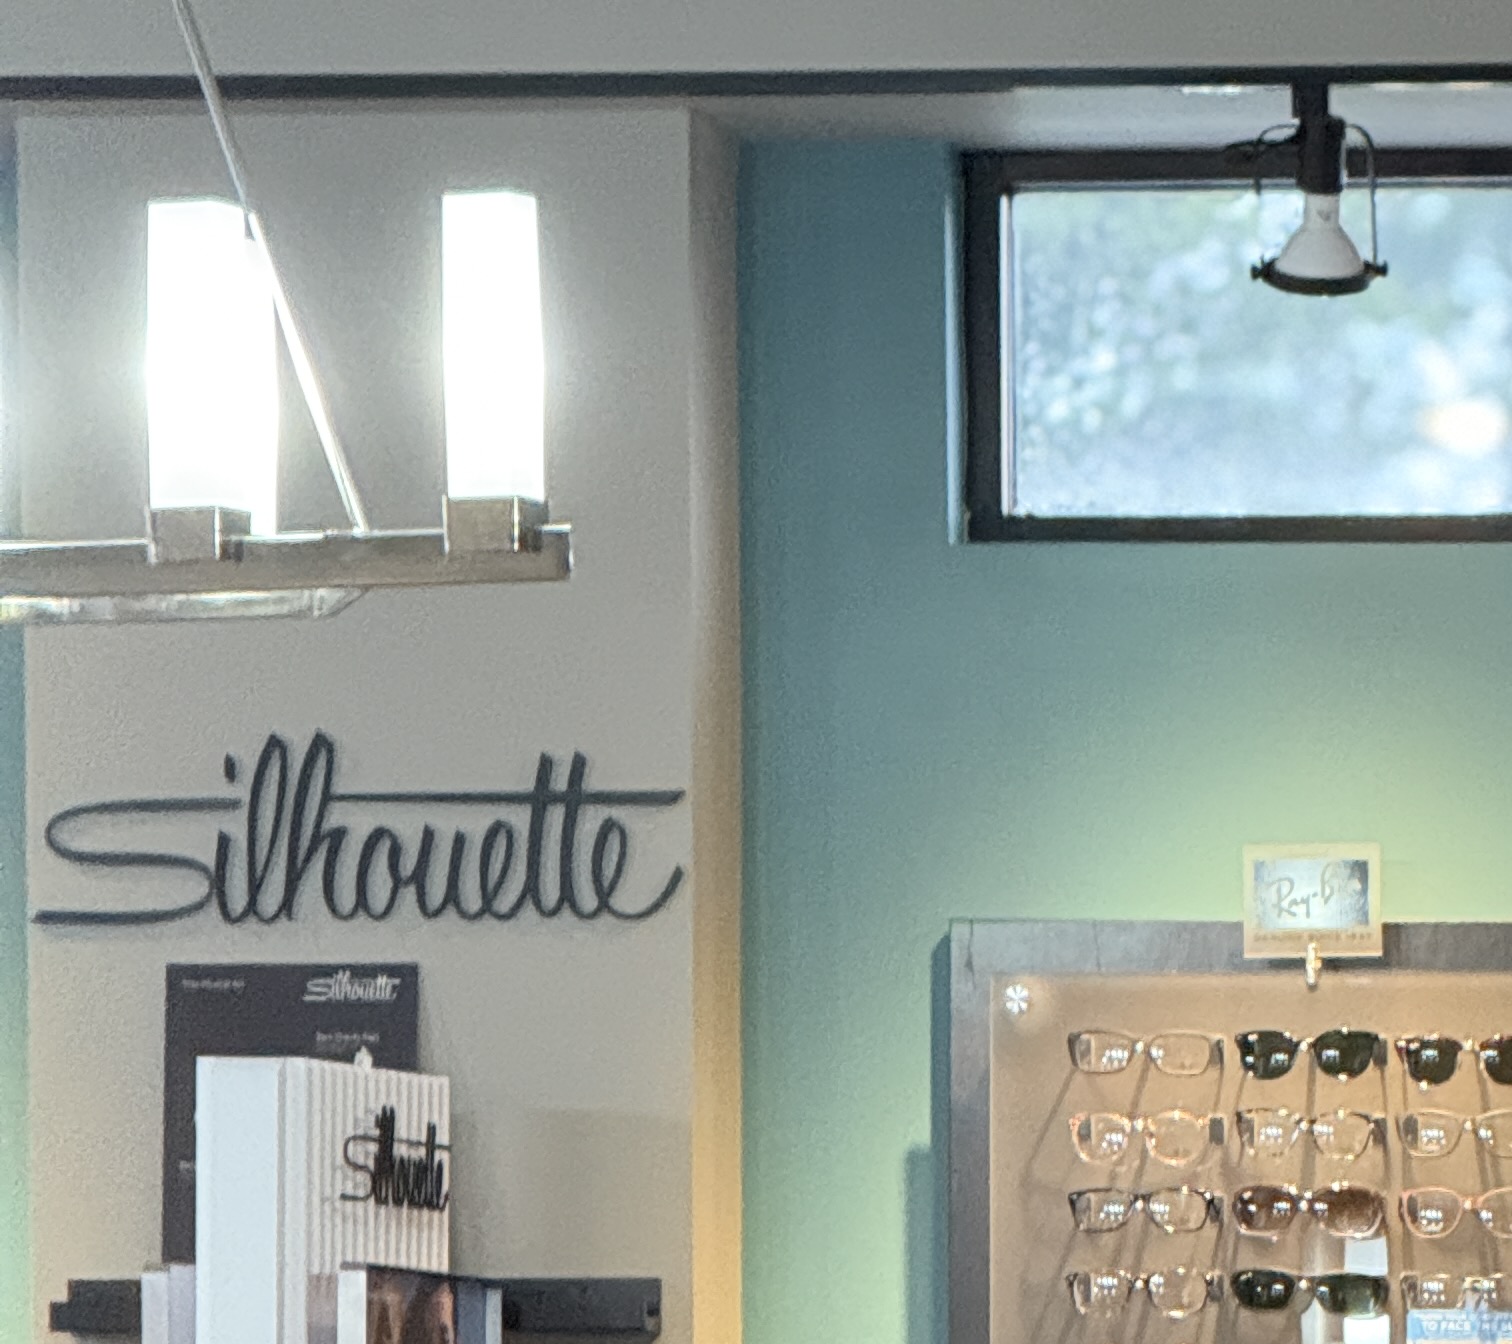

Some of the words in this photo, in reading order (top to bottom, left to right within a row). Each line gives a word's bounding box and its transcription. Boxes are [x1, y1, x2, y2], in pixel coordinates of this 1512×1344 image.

[32, 728, 686, 925] Silhouette
[302, 969, 401, 1003] Silhouette
[1440, 1320, 1472, 1331] FACE
